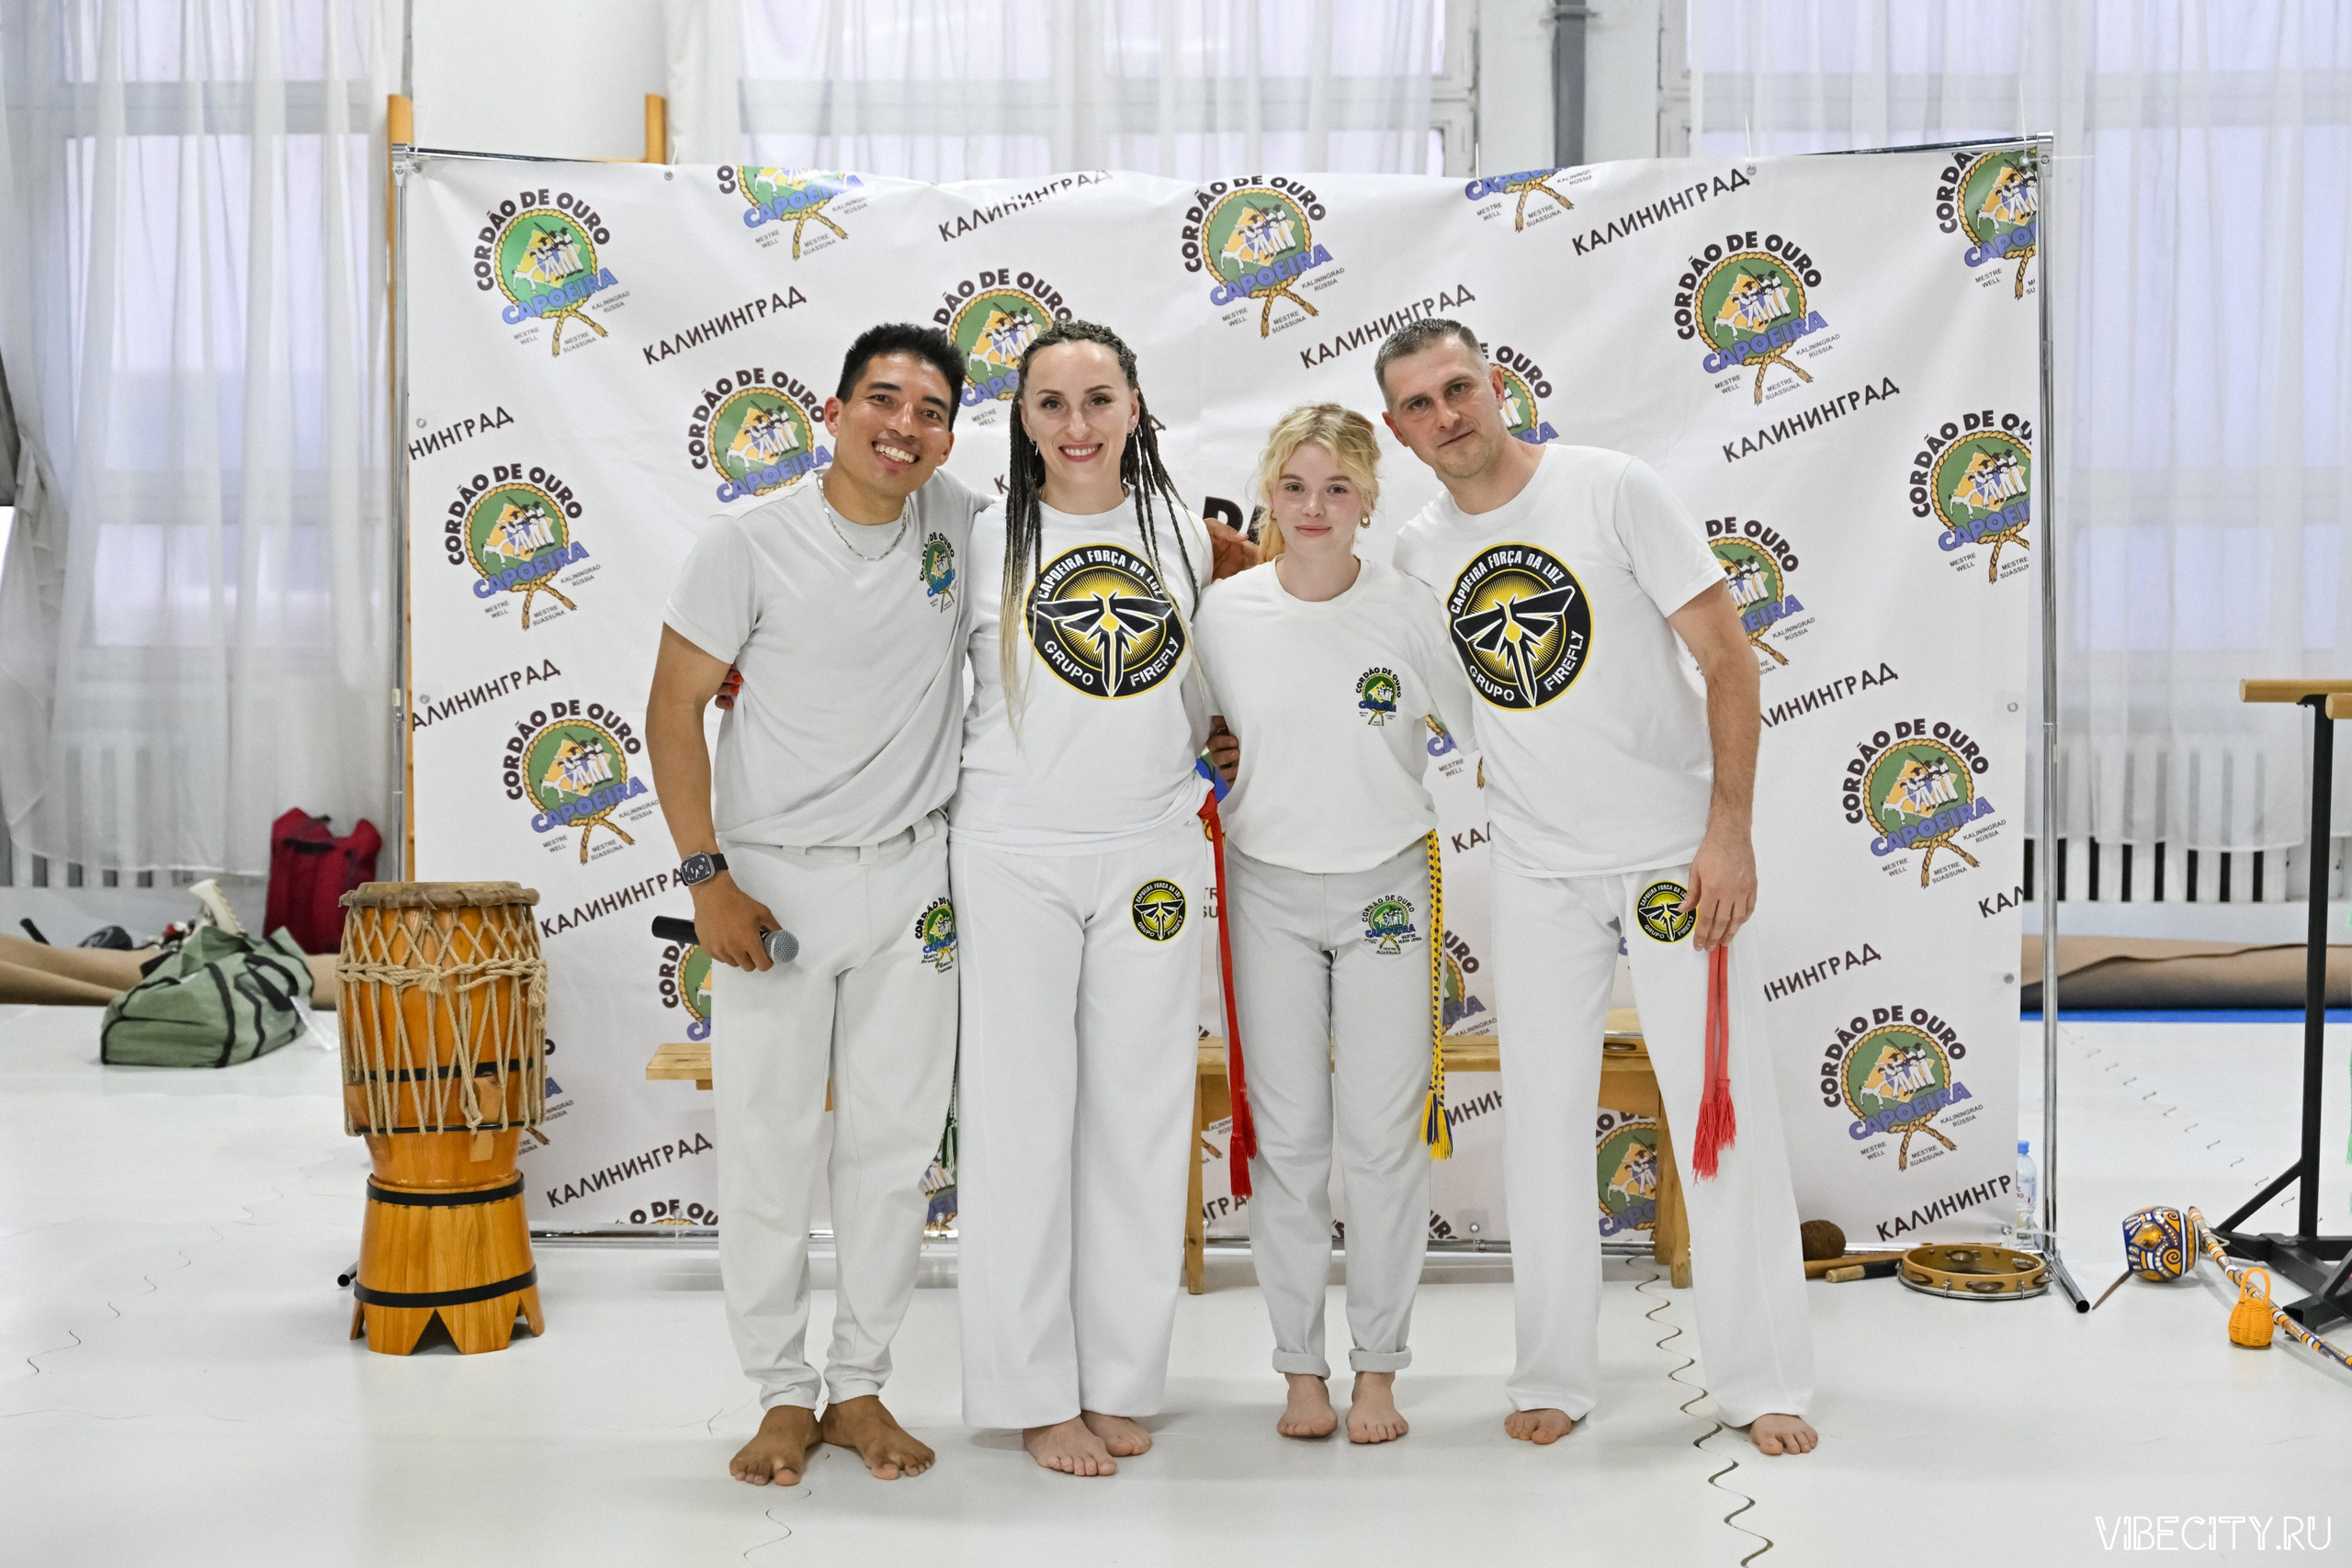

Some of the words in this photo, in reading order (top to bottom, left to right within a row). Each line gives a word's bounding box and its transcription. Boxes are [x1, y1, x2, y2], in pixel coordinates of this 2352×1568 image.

[1528, 204, 1555, 220] MESTRE
[1572, 168, 1750, 256] КАЛИНИНГРАД
[1182, 182, 1227, 273] CORDÃO
[1233, 175, 1263, 187] DE
[1271, 176, 1327, 221] OURO
[474, 200, 516, 291] CORDÃO
[520, 189, 549, 208] DE
[557, 193, 610, 244] OURO
[803, 233, 829, 248] MESTRE
[1210, 244, 1332, 305] CAPOEIRA
[1303, 267, 1344, 288] KALININGRAD
[1975, 268, 2002, 283] MESTRE
[1982, 278, 2000, 289] WELL
[1675, 244, 1722, 339] CORDÃO
[1726, 231, 1758, 252] DE
[1765, 234, 1821, 287] OURO
[502, 267, 618, 324] CAPOEIRA
[592, 291, 629, 310] KALININGRAD
[978, 268, 1009, 288] DE
[1016, 274, 1072, 324] OURO
[1222, 308, 1248, 321] MESTRE
[1227, 317, 1246, 327] WELL
[1272, 310, 1299, 325] MESTRE
[643, 286, 807, 365] КАЛИНИНГРАД
[1271, 315, 1307, 333] SUASSUNA
[1300, 284, 1476, 368] КАЛИНИНГРАД
[514, 327, 539, 340] MESTRE
[520, 336, 537, 346] WELL
[564, 332, 589, 344] MESTRE
[1703, 310, 1827, 373] CAPOEIRA
[563, 336, 596, 353] SUASSUNA
[1797, 334, 1839, 355] KALININGRAD
[1497, 346, 1551, 398] OURO
[1714, 375, 1741, 389] MESTRE
[1721, 384, 1739, 395] WELL
[1764, 382, 1801, 400] SUASSUNA
[1766, 378, 1792, 392] MESTRE
[689, 378, 732, 468] CORDÃO
[736, 367, 765, 387] DE
[773, 371, 826, 423] OURO
[971, 409, 997, 423] MESTRE
[978, 419, 996, 429] WELL
[1722, 377, 1900, 463] КАЛИНИНГРАД
[1910, 423, 1958, 517] CORDÃO
[1962, 411, 1994, 431] DE
[717, 446, 833, 502] CAPOEIRA
[445, 474, 489, 565] CORDÃO
[492, 463, 522, 482] DE
[529, 467, 582, 518] OURO
[1707, 517, 1737, 537] DE
[1745, 521, 1798, 571] OURO
[1950, 553, 1976, 567] MESTRE
[1956, 562, 1974, 573] WELL
[2002, 556, 2029, 570] MESTRE
[473, 541, 589, 598] CAPOEIRA
[561, 564, 601, 583] KALININGRAD
[1038, 553, 1085, 599] CAPOEIRA
[1086, 549, 1126, 567] FORÇA
[1129, 560, 1146, 578] DA
[1451, 561, 1487, 615] CAPOEIRA
[1487, 550, 1522, 568] FORÇA
[1525, 553, 1543, 570] DA
[1543, 562, 1565, 584] LUZ
[484, 601, 508, 614] MESTRE
[490, 610, 507, 619] WELL
[533, 605, 558, 618] MESTRE
[532, 610, 566, 626] SUASSUNA
[1774, 617, 1815, 638] KALININGRAD
[1045, 640, 1094, 686] GRUPO
[1130, 637, 1180, 687] FIREFLY
[1543, 630, 1584, 692] FIREFLY
[1382, 667, 1392, 676] DE
[1393, 674, 1401, 698] OURO
[1470, 665, 1515, 702] GRUPO
[503, 710, 547, 800] CORDÃO
[550, 700, 580, 718] DE
[587, 704, 639, 754] OURO
[1439, 758, 1464, 773] MESTRE
[1445, 767, 1464, 777] WELL
[1843, 730, 1890, 823] CORDÃO
[1894, 718, 1926, 739] DE
[1933, 722, 1988, 773] OURO
[531, 777, 647, 832] CAPOEIRA
[619, 800, 658, 818] KALININGRAD
[1871, 796, 1994, 856] CAPOEIRA
[1964, 819, 2007, 840] KALININGRAD
[543, 835, 568, 848] MESTRE
[548, 844, 567, 853] WELL
[592, 840, 616, 852] MESTRE
[590, 844, 623, 861] SUASSUNA
[1883, 858, 1908, 872] MESTRE
[1888, 867, 1906, 877] WELL
[1932, 862, 1959, 875] MESTRE
[1930, 866, 1967, 884] SUASSUNA
[1365, 923, 1416, 938] CAPOEIRA
[1821, 1017, 1868, 1107] CORDÃO
[1872, 1006, 1903, 1025] DE
[1911, 1009, 1965, 1059] OURO
[1849, 1082, 1971, 1139] CAPOEIRA
[1941, 1104, 1983, 1124] KALININGRAD
[1860, 1142, 1886, 1155] MESTRE
[1867, 1151, 1884, 1160] WELL
[1910, 1145, 1937, 1158] MESTRE
[1908, 1150, 1945, 1167] SUASSUNA
[547, 1133, 713, 1208] КАЛИНИНГРАД
